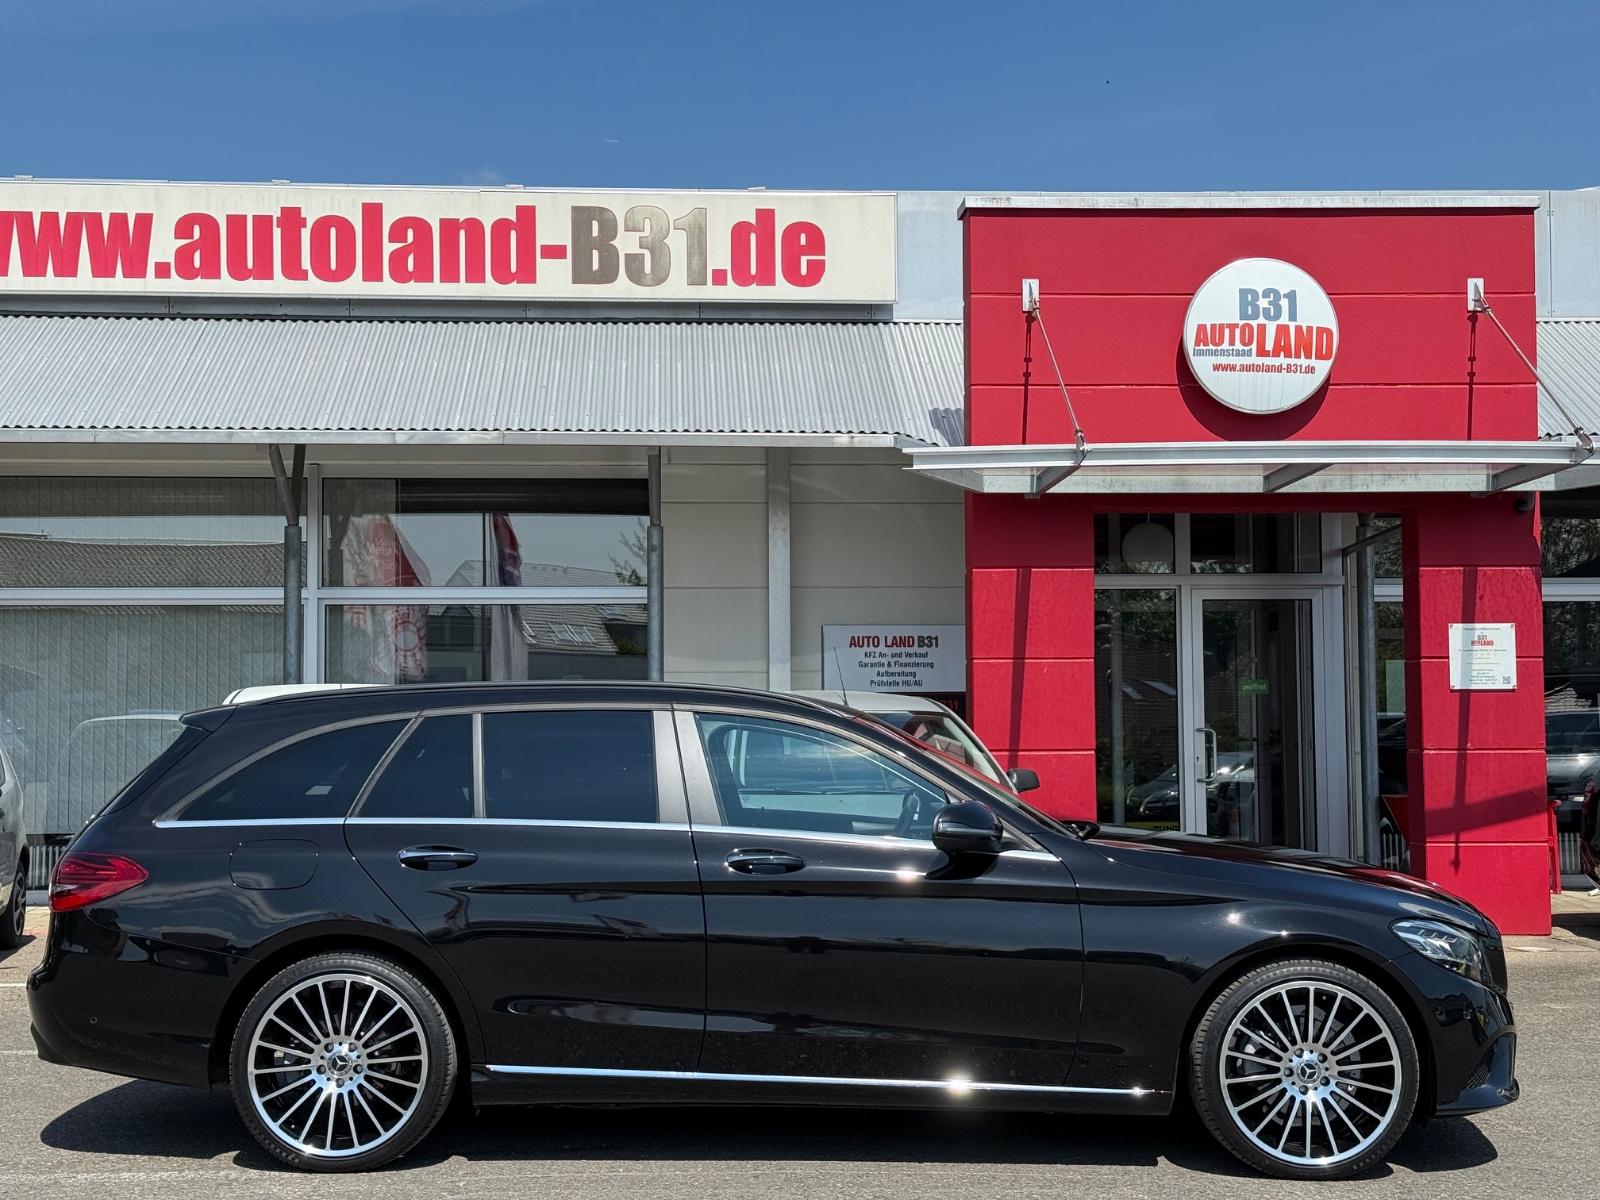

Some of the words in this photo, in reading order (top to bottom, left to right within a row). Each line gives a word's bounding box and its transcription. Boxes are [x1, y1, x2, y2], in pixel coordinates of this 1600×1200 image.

[0, 202, 826, 288] ww.autoland-B31.de
[1238, 287, 1298, 322] B31
[1192, 347, 1252, 358] Immenstaad
[1212, 362, 1316, 375] www.autoland-B31.de
[849, 635, 880, 649] AUTO
[884, 635, 915, 649] LAND
[917, 635, 939, 649] B31
[864, 651, 877, 659] KFZ
[878, 651, 890, 659] An-
[891, 651, 903, 659] und
[905, 651, 929, 659] Verkauf
[858, 660, 886, 668] Garantie
[887, 660, 892, 668] &
[894, 660, 934, 669] Finanzierung
[876, 670, 917, 679] Aufbereitung
[870, 679, 900, 687] Prüfstelle
